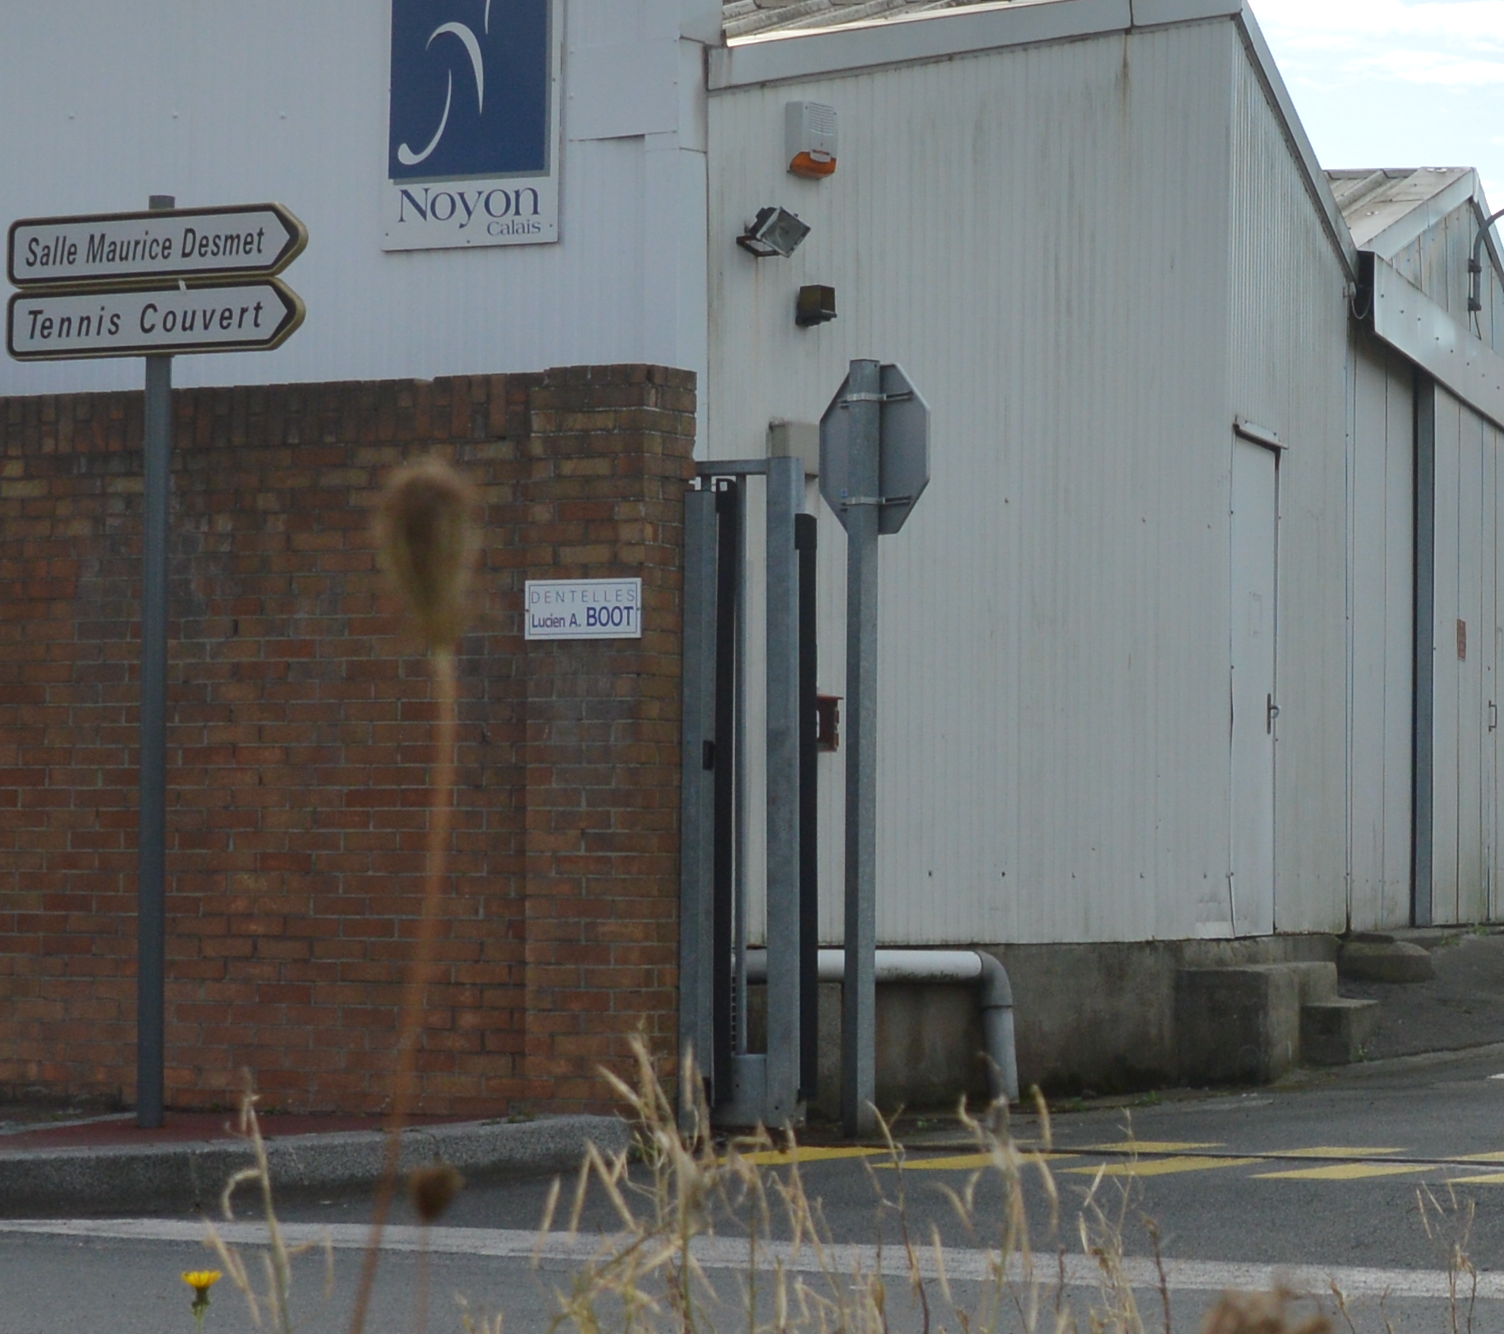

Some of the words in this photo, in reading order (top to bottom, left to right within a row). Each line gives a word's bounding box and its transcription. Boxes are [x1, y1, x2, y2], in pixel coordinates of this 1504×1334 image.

[397, 186, 541, 230] Noyon
[486, 219, 542, 237] Calais
[25, 236, 78, 268] Salle
[85, 230, 173, 265] Maurice
[181, 227, 265, 259] Desmet
[27, 306, 121, 341] Tennis
[139, 301, 264, 334] Couvert
[531, 589, 635, 604] DENTELLES
[531, 612, 566, 629] Lucien
[569, 613, 582, 628] A.
[586, 606, 634, 627] BOOT
